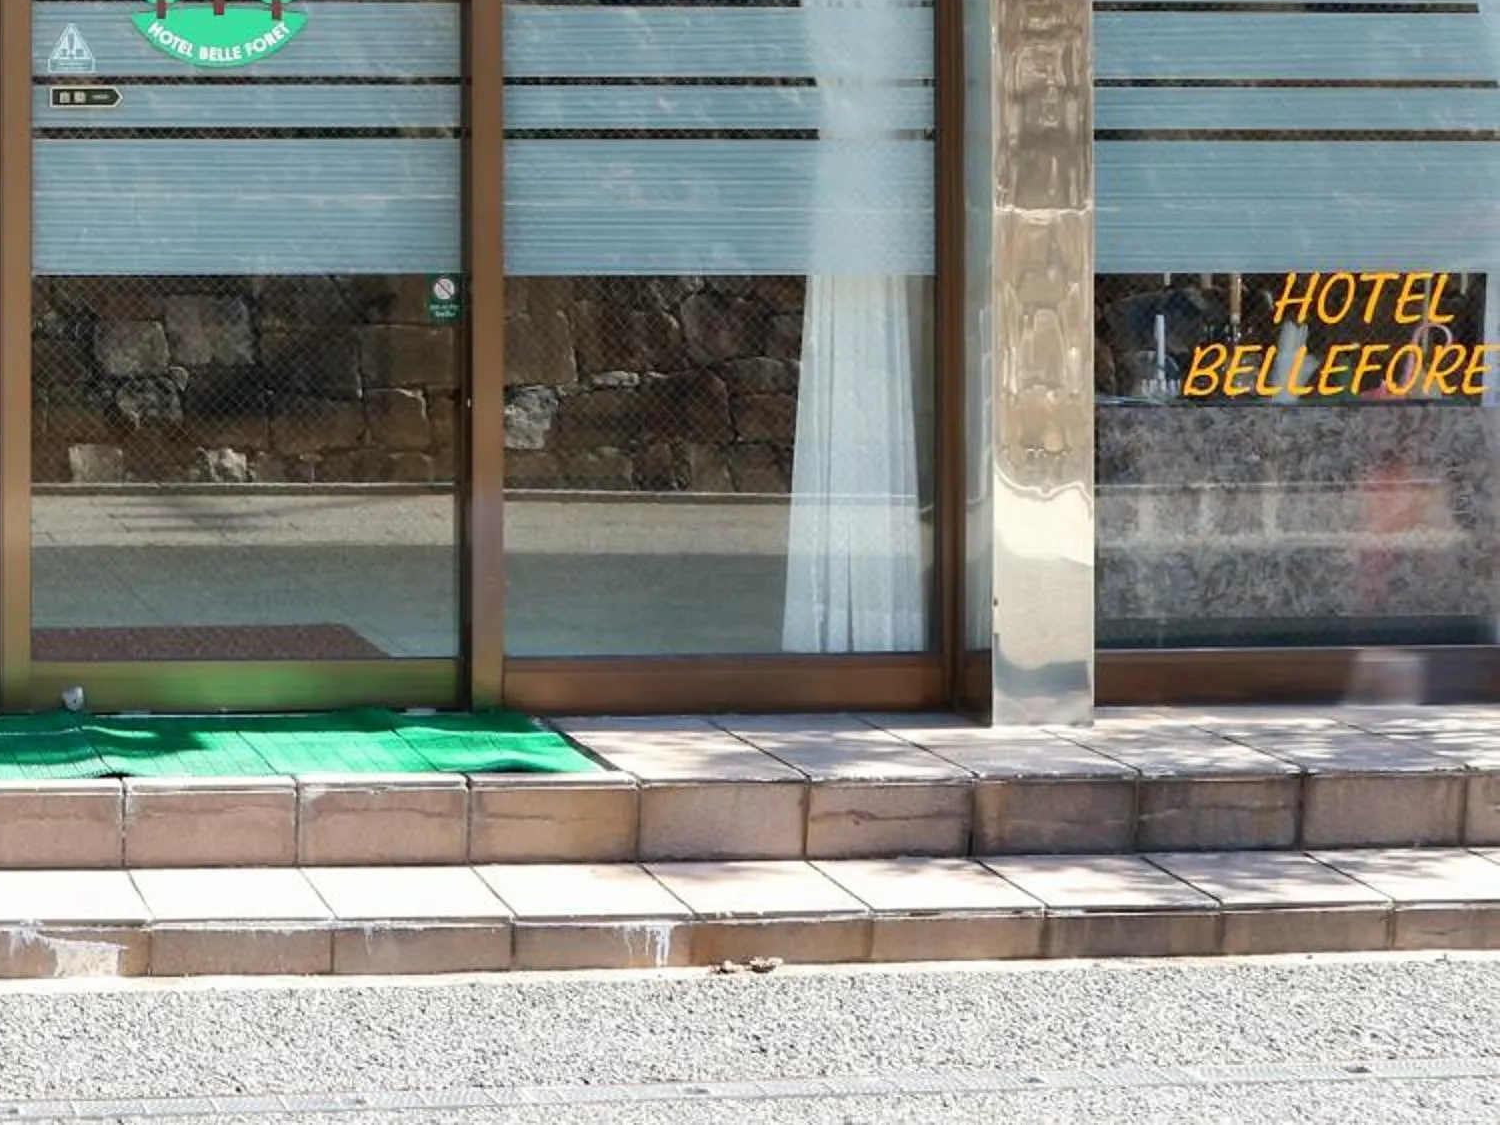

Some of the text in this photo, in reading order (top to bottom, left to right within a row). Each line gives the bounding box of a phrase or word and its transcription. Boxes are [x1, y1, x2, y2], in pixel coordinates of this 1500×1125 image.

[147, 21, 291, 61] HOTEL BELLE FORET
[1273, 271, 1455, 325] HOTEL
